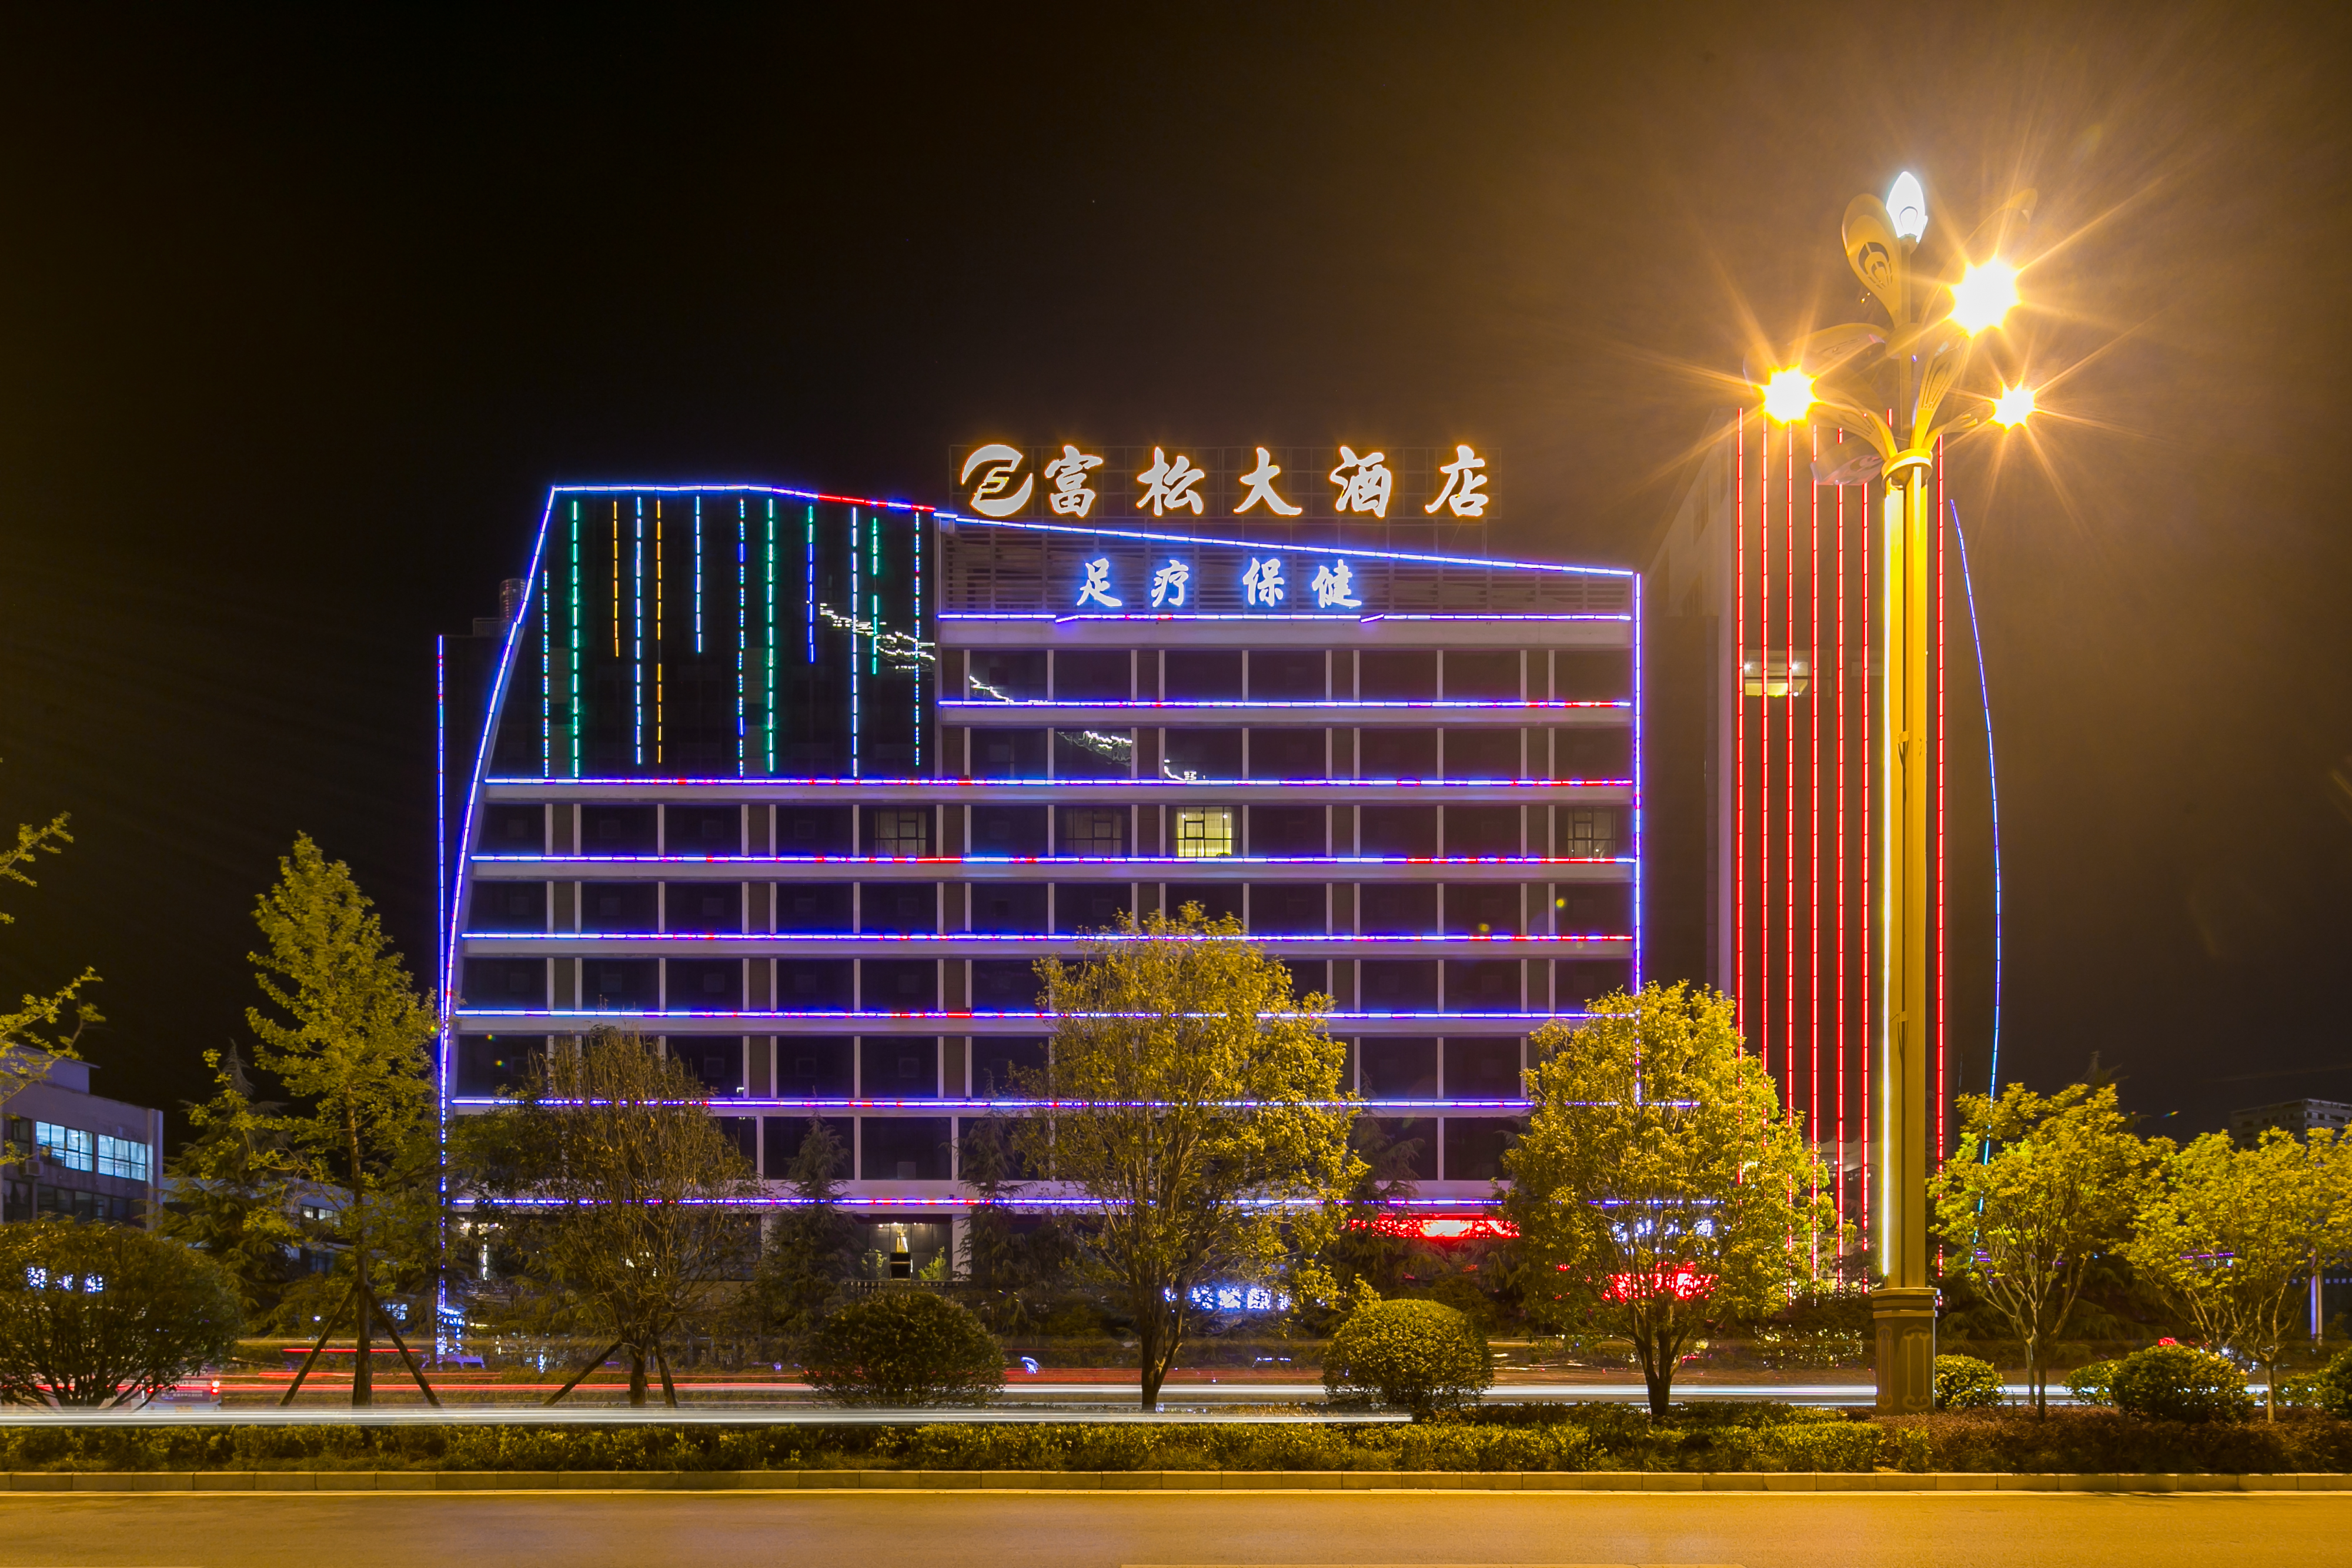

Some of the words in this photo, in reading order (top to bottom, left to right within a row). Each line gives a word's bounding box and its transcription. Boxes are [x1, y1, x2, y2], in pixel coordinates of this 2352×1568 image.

[1043, 444, 1489, 518] 富松大酒店
